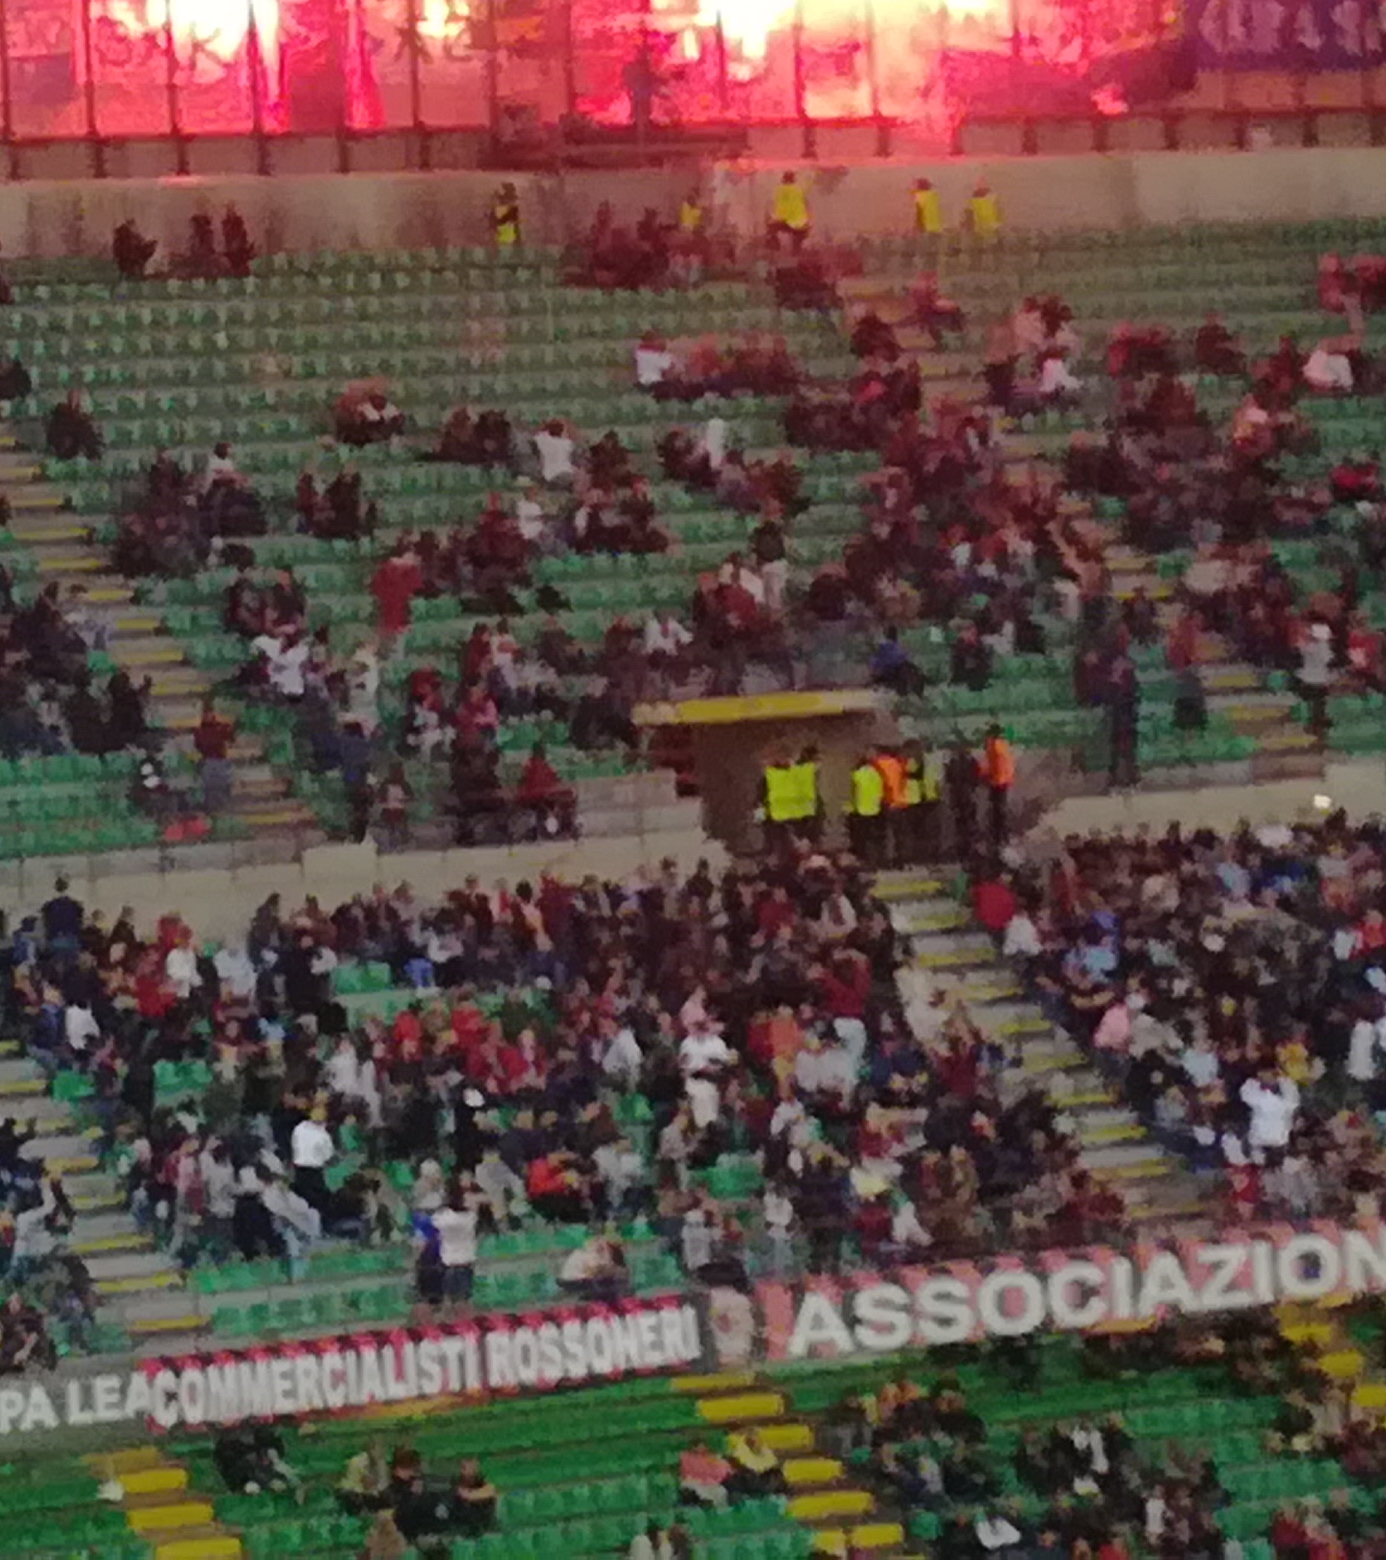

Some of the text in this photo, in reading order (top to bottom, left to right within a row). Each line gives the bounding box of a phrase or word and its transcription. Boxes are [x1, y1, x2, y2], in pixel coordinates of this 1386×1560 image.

[66, 1370, 153, 1425] LEA
[151, 1306, 702, 1427] COMMERCIALISTI ROSSONERI
